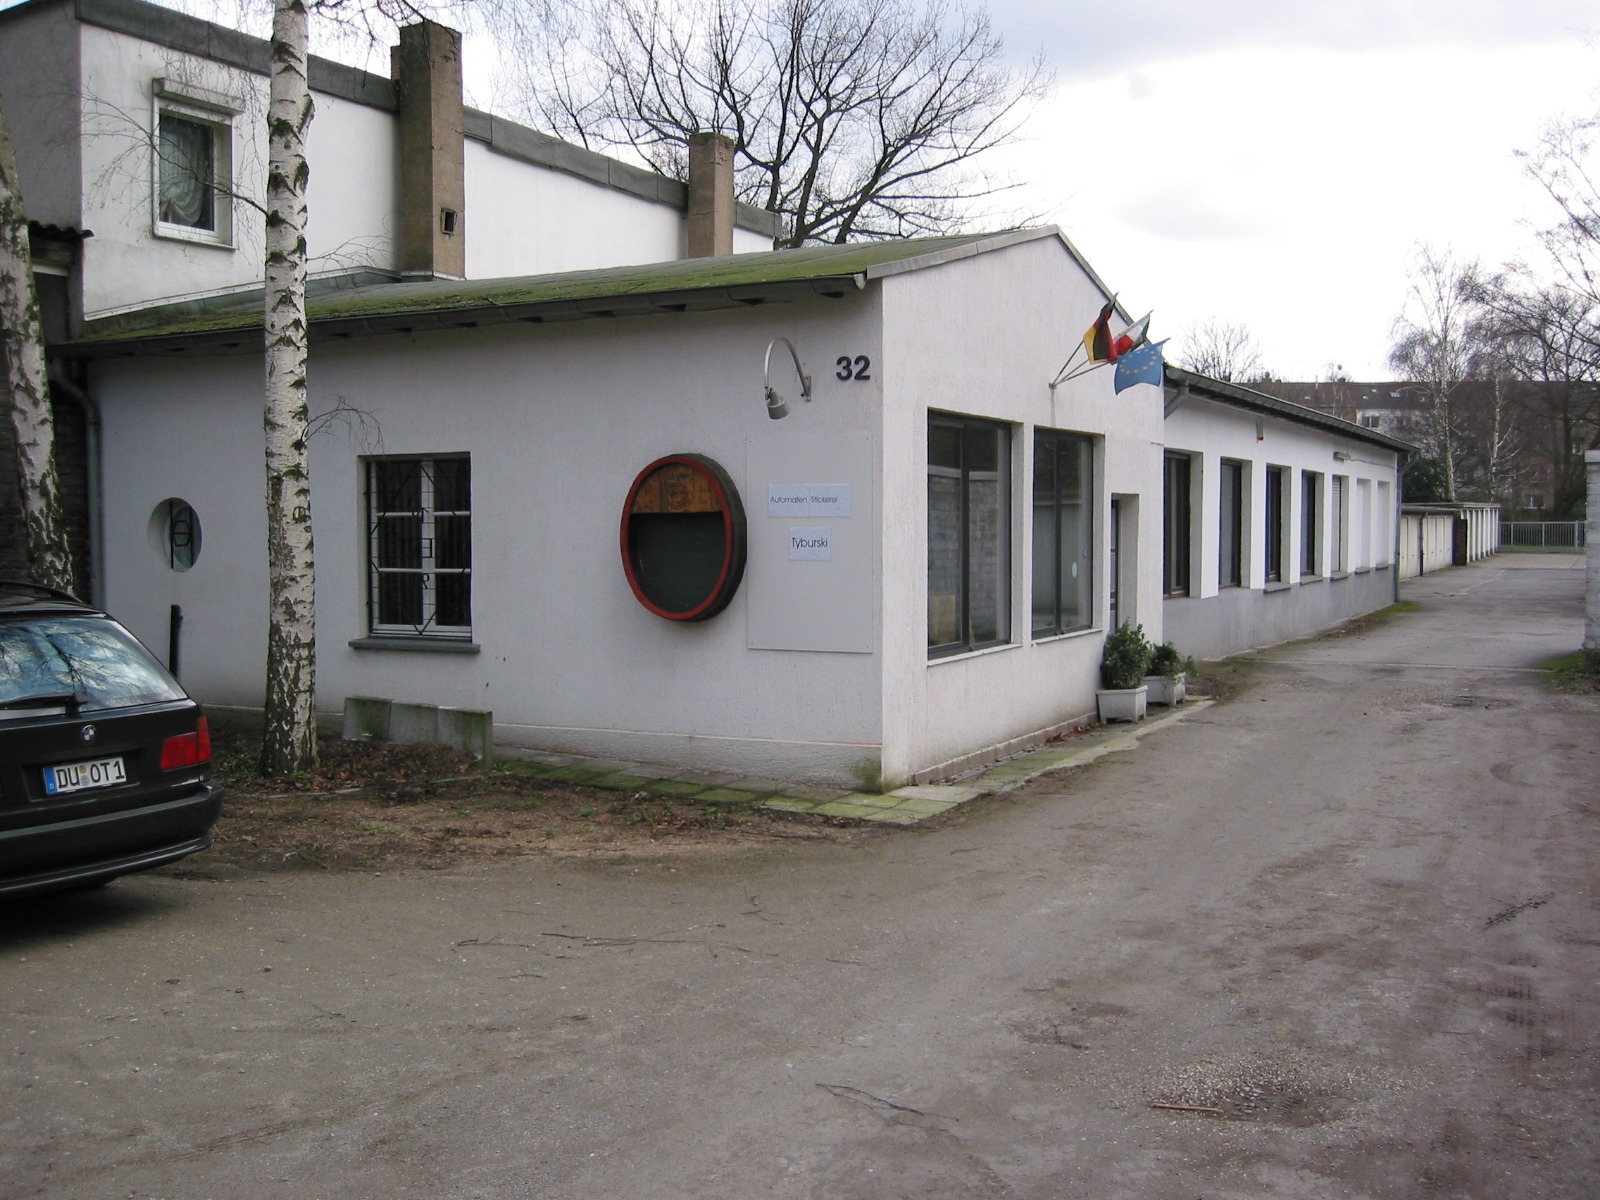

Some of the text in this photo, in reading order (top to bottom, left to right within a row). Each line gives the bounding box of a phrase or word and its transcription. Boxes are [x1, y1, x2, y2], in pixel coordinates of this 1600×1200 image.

[836, 355, 870, 381] 32
[810, 495, 838, 503] Stickerei
[792, 537, 828, 549] Tyburski
[56, 766, 80, 788] DU
